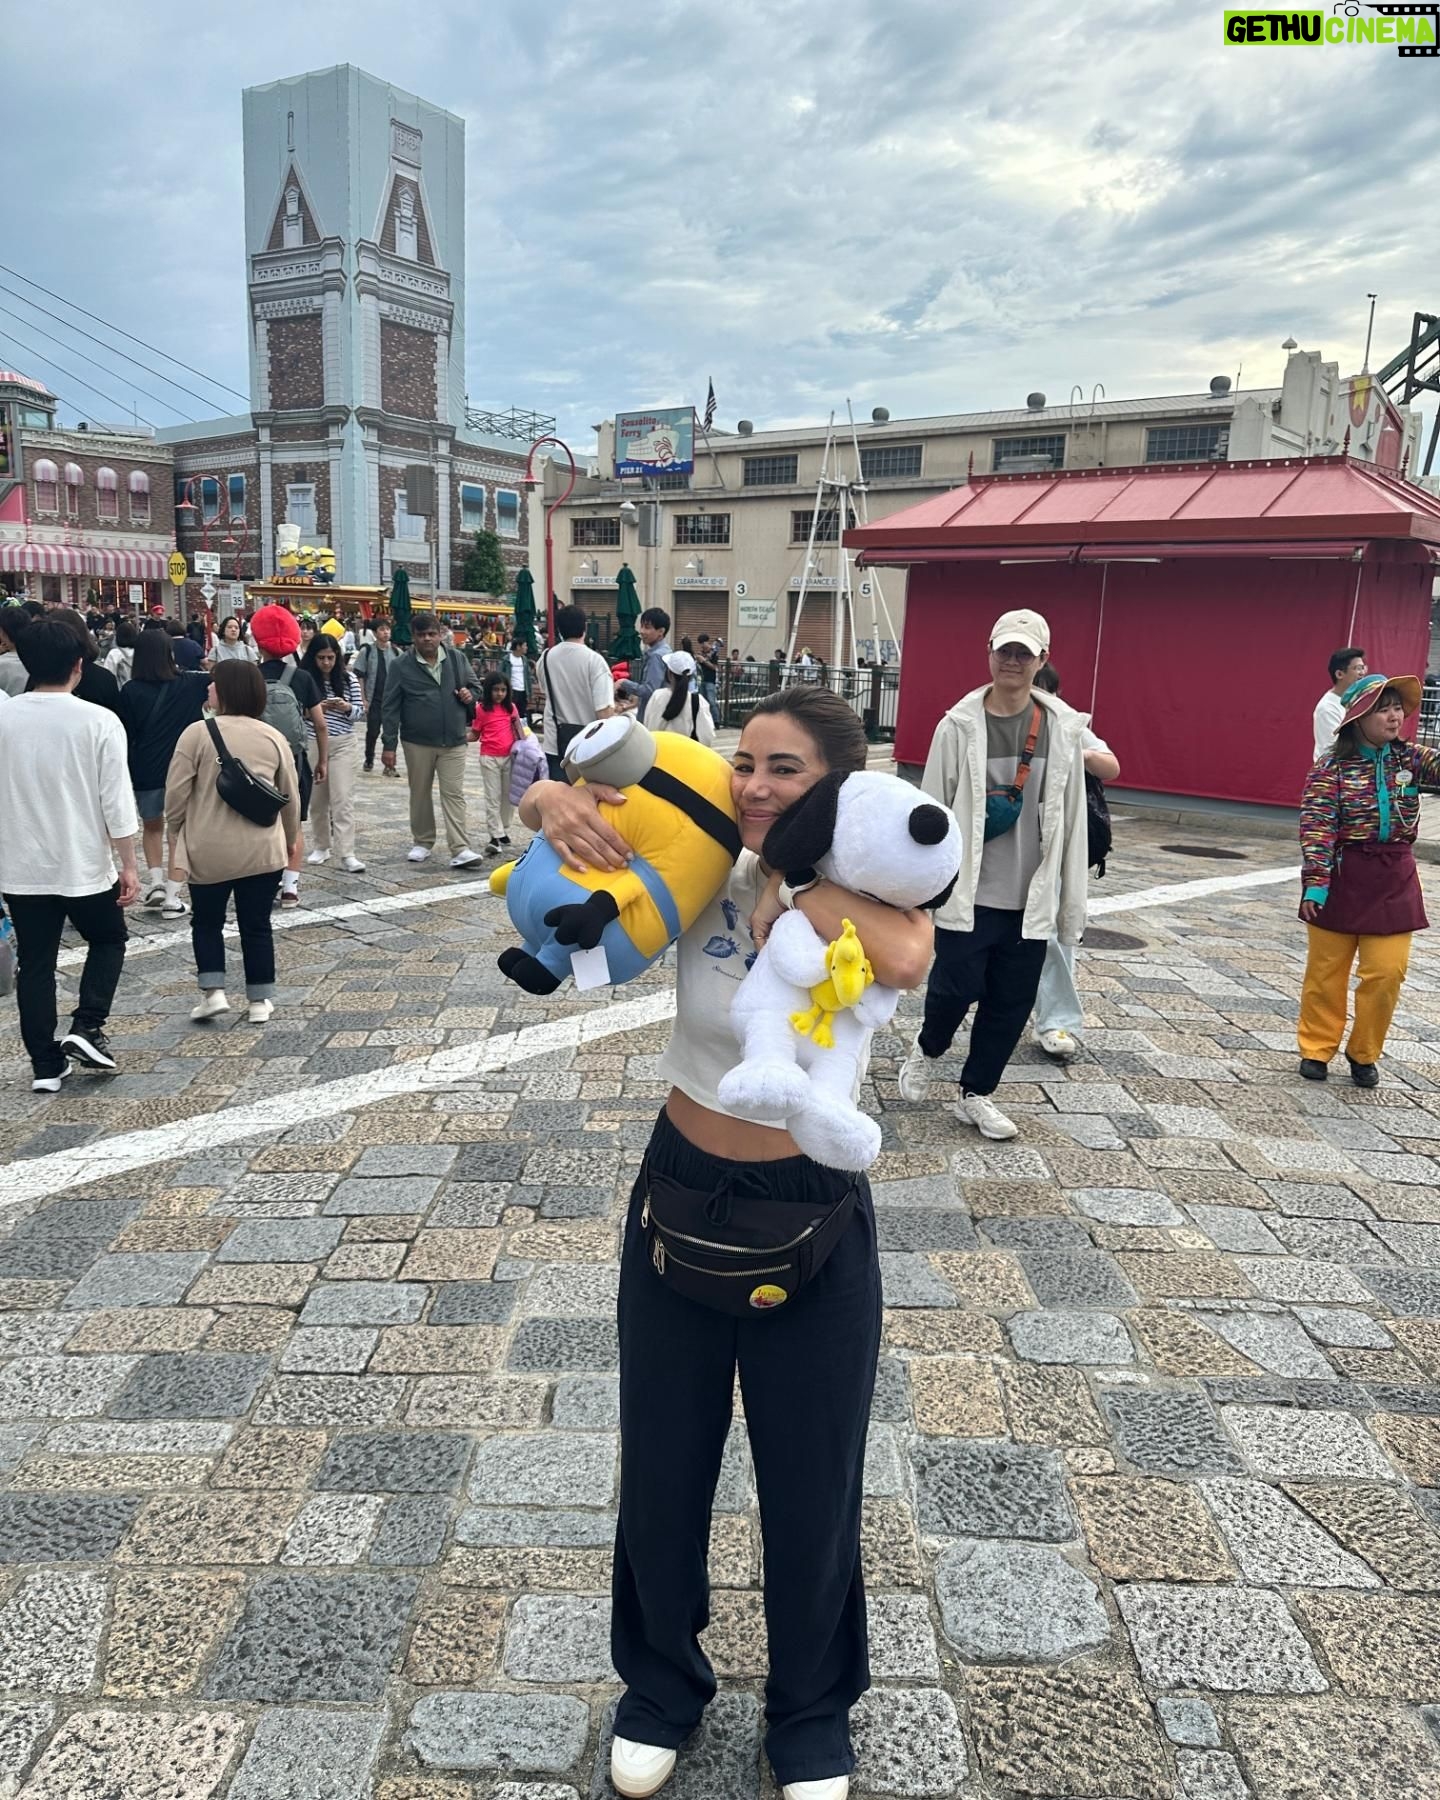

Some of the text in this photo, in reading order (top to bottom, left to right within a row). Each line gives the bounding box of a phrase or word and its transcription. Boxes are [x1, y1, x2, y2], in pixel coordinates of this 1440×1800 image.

[621, 416, 657, 428] Sausalito
[621, 429, 641, 438] Ferry
[170, 563, 185, 575] STOP
[737, 584, 745, 594] 3
[862, 584, 870, 594] 5
[232, 597, 242, 605] 35
